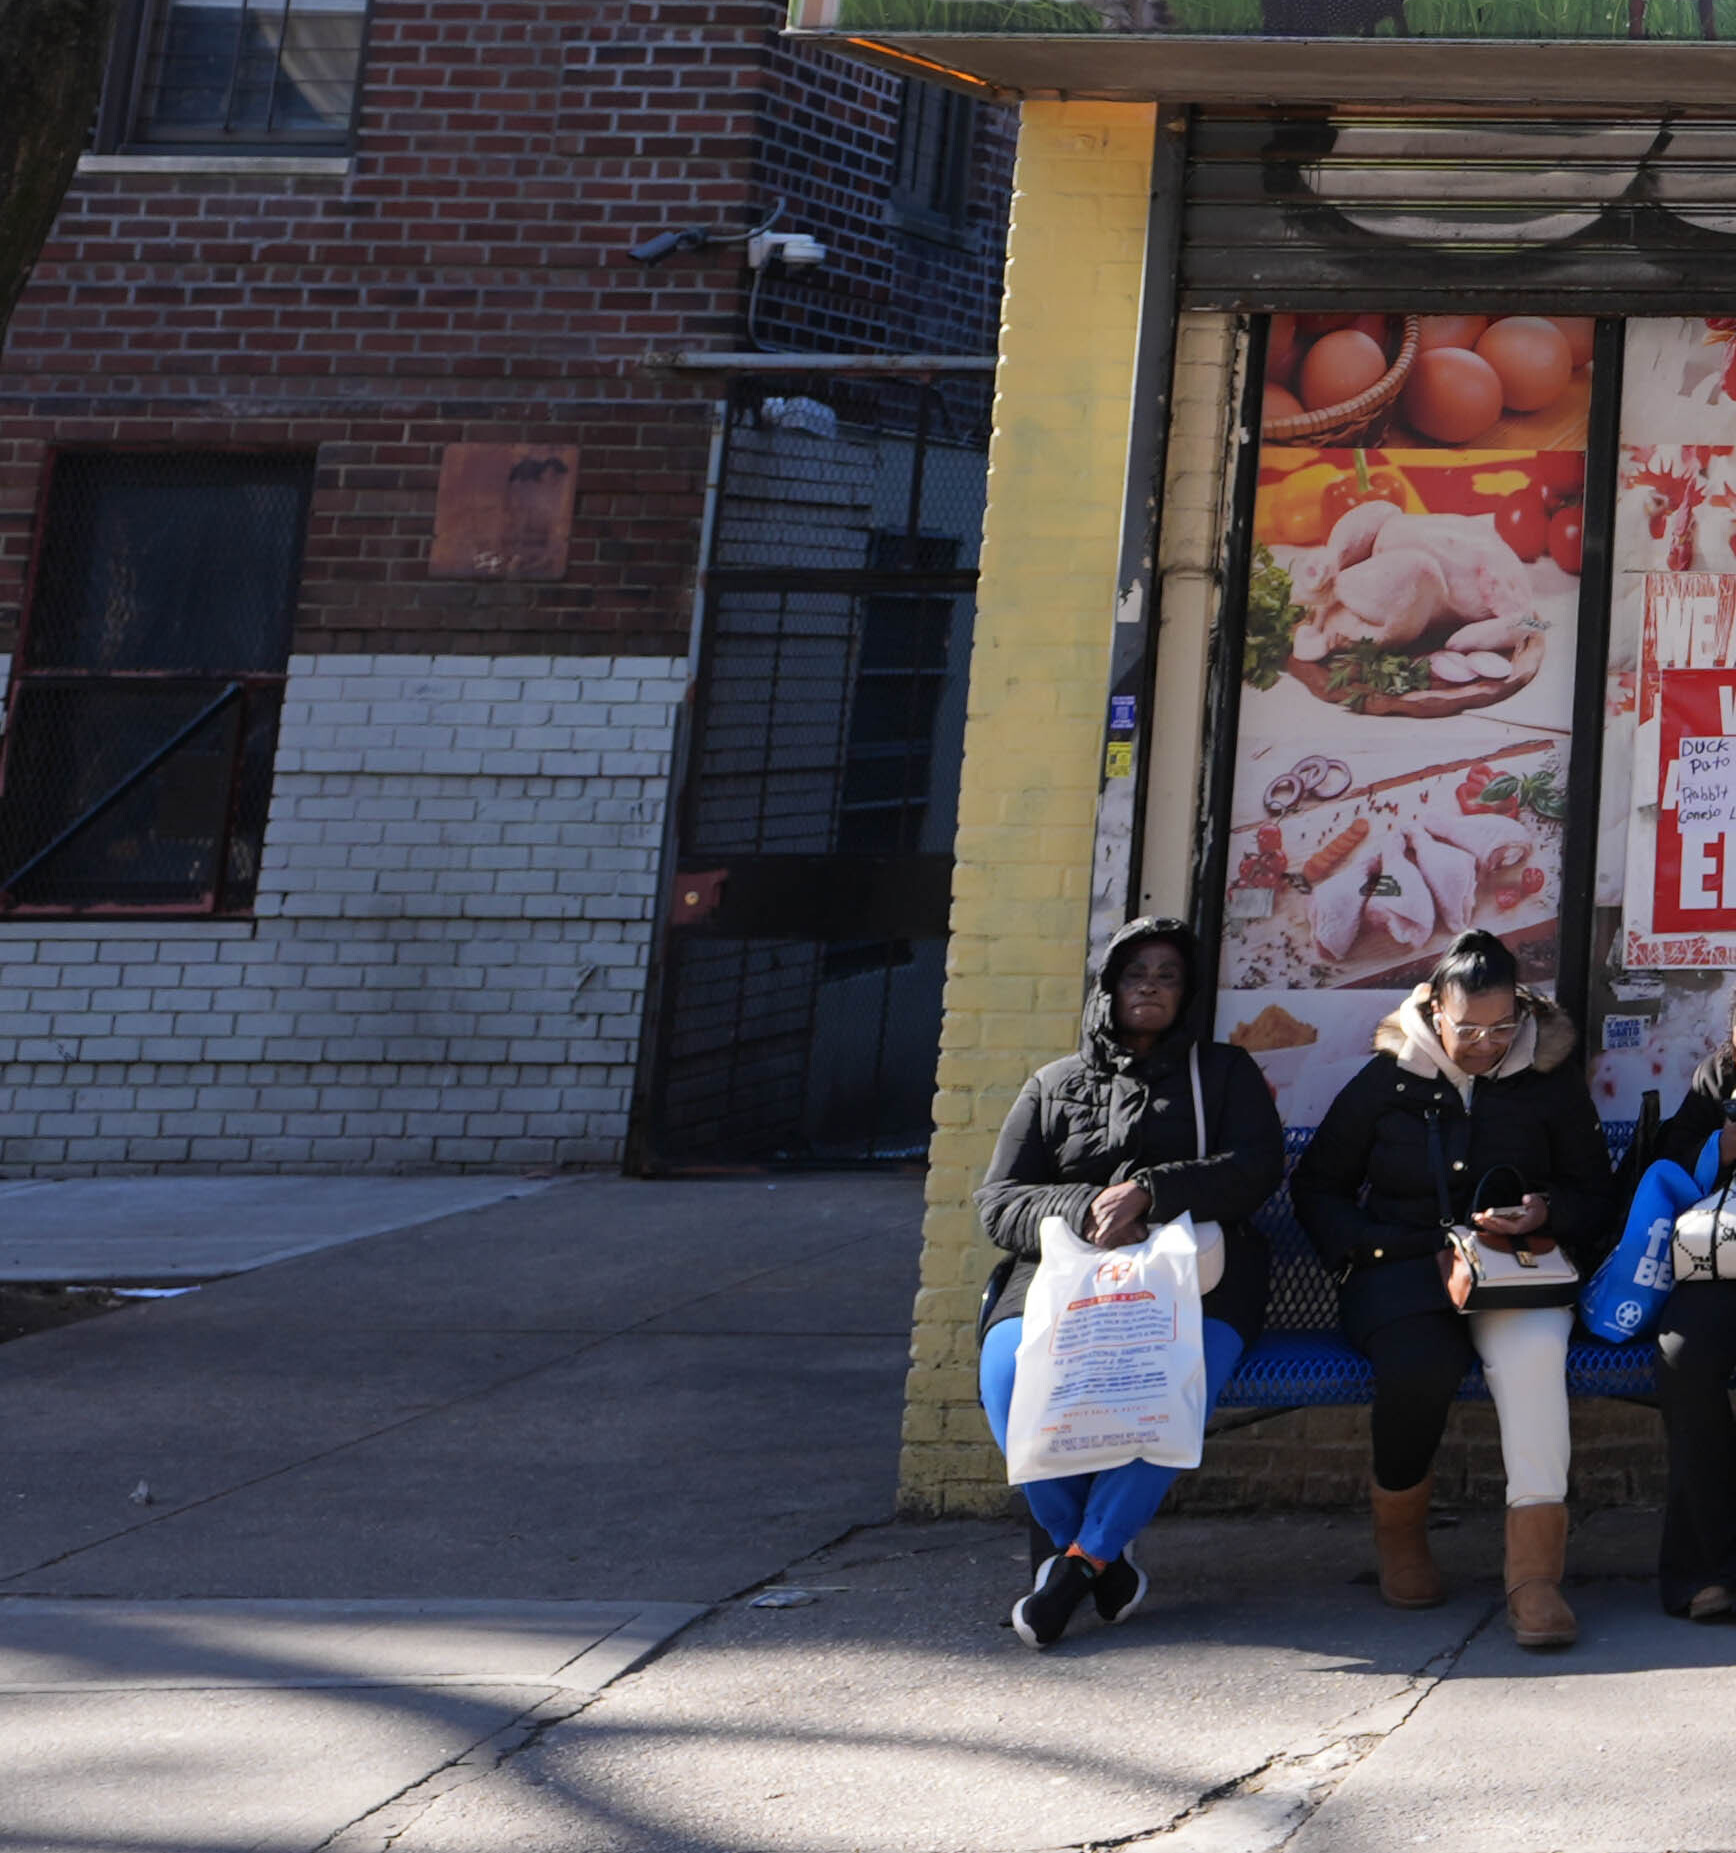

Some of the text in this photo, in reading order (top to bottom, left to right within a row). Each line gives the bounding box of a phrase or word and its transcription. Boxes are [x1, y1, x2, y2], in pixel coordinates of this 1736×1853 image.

[1655, 595, 1720, 669] WE
[1682, 739, 1730, 757] DUCK
[1690, 756, 1730, 775] Pato
[1678, 804, 1721, 824] Conejo
